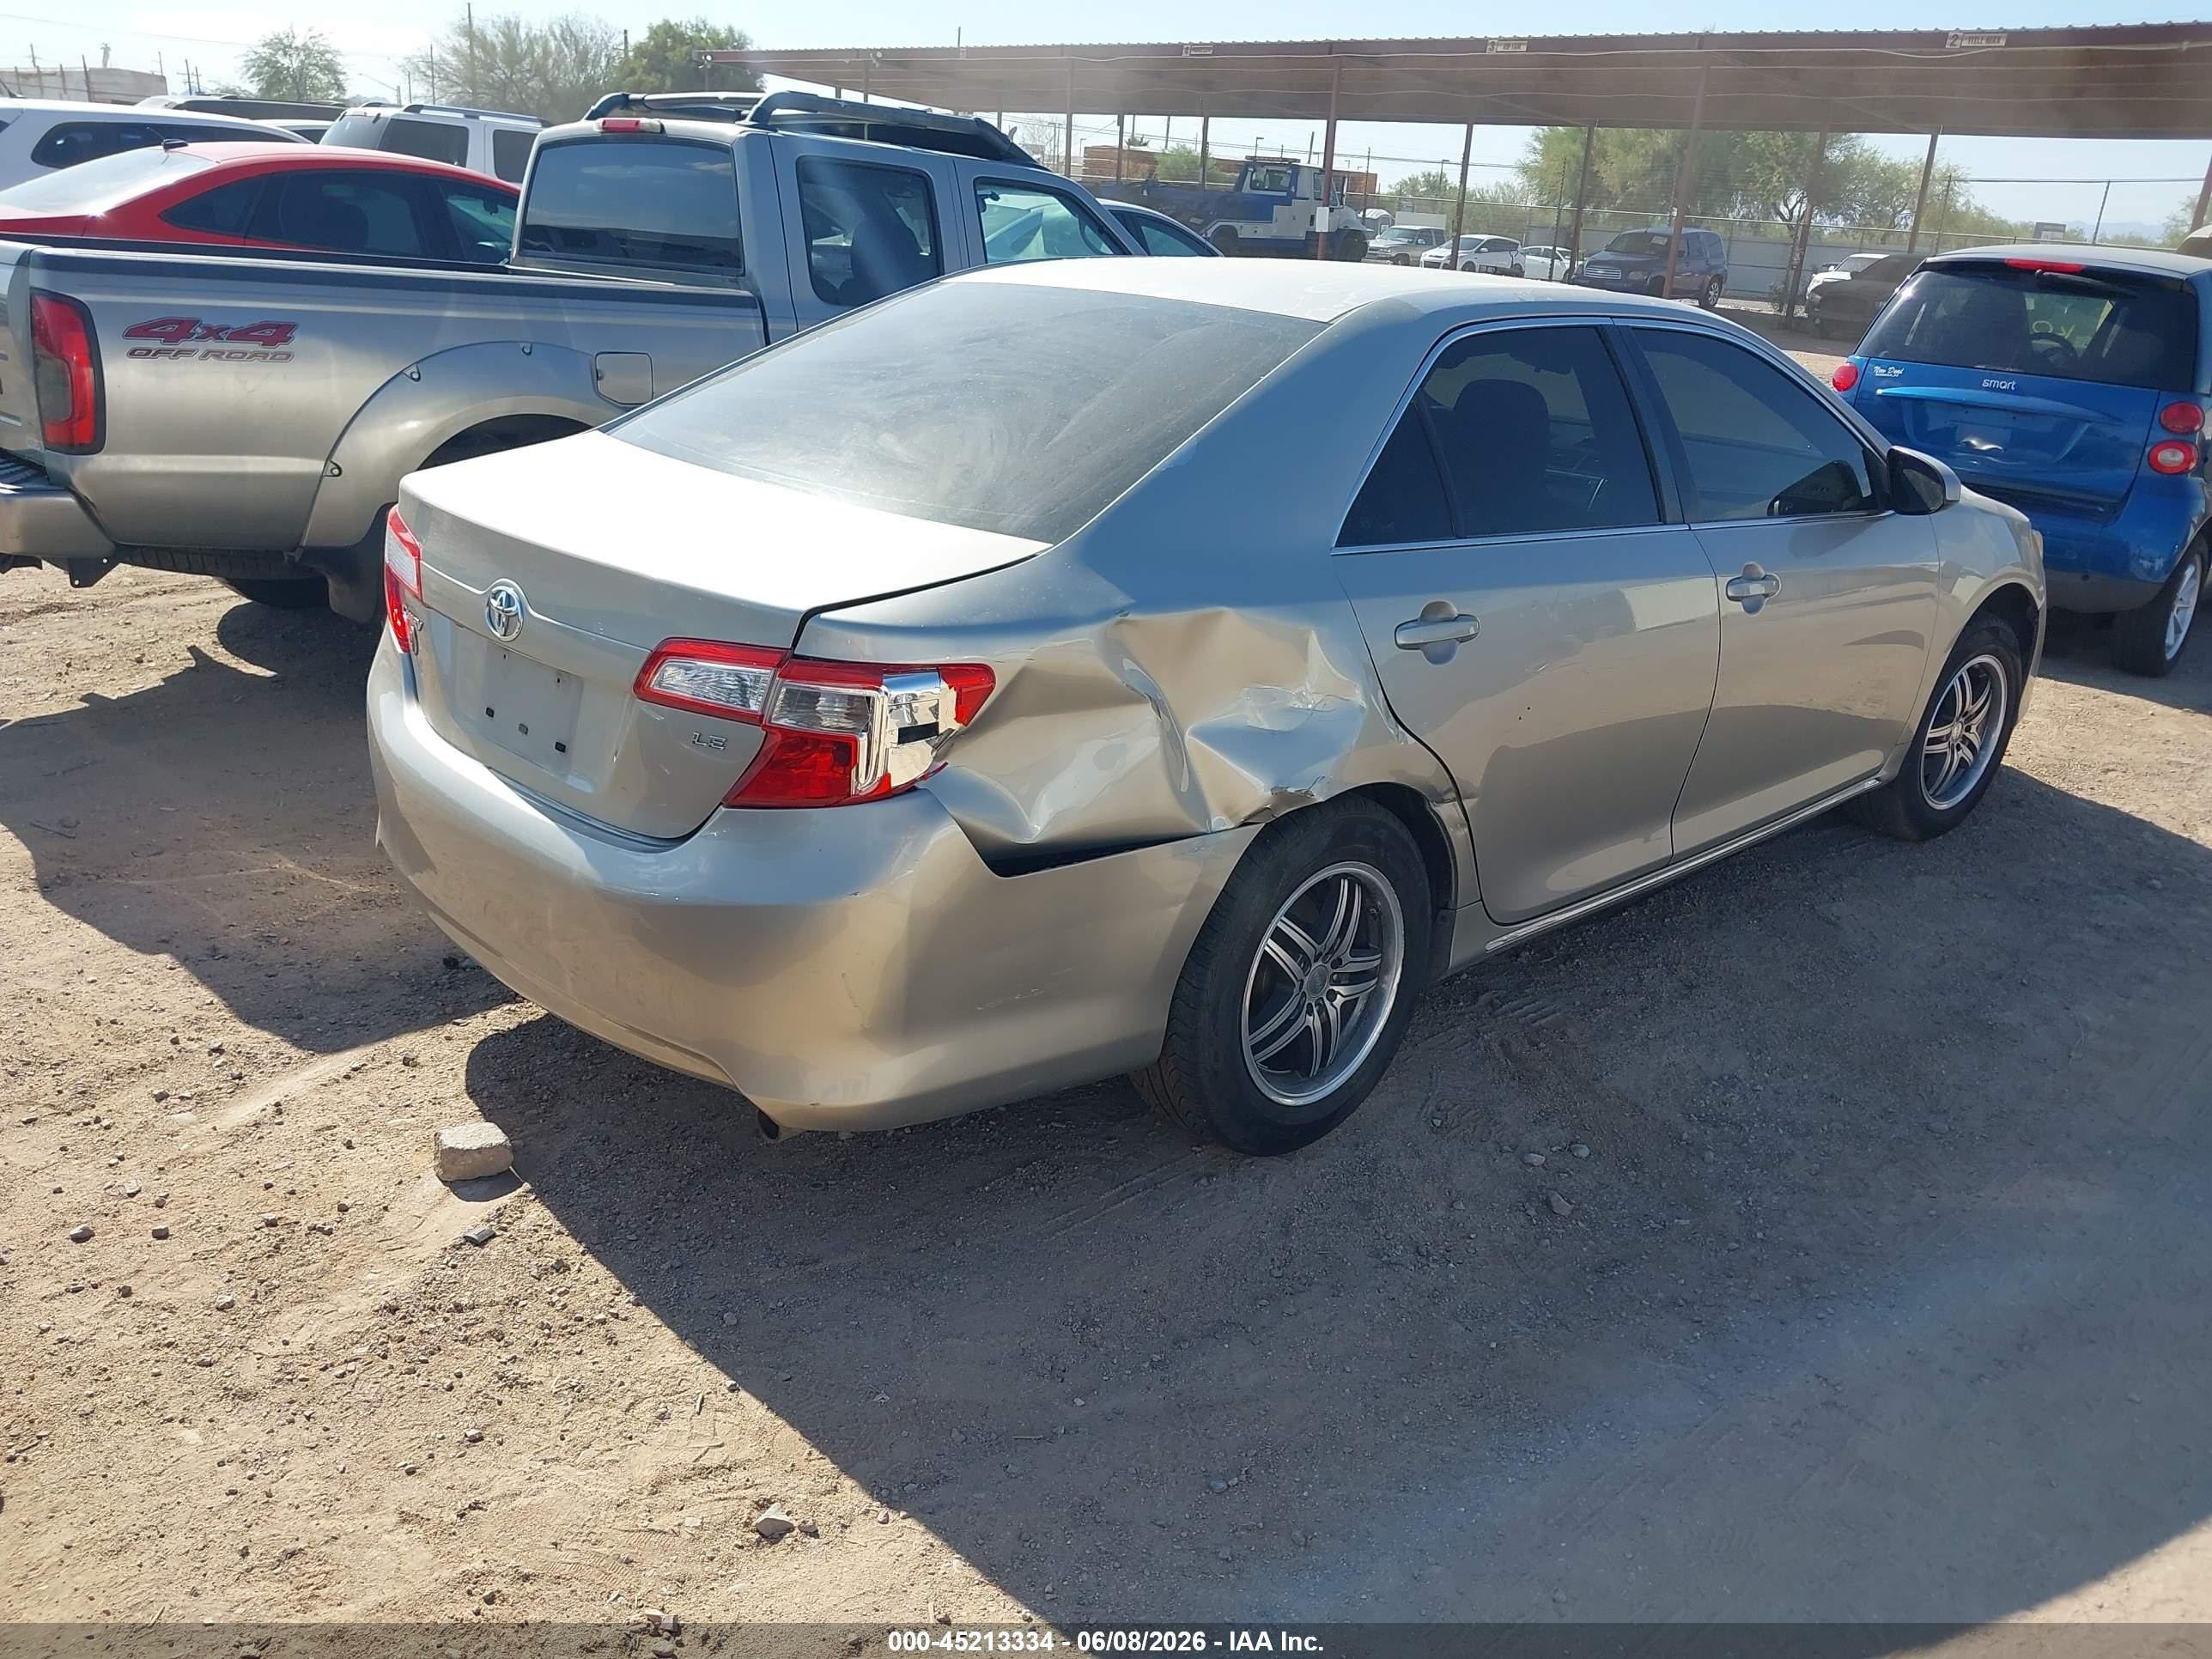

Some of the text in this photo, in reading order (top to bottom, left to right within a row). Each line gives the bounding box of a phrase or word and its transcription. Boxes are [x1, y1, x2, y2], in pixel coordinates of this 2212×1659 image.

[1948, 33, 1959, 46] 2
[123, 316, 300, 349] 4x4
[126, 346, 295, 363] OFF ROAD
[1982, 379, 2016, 391] smart
[692, 732, 726, 750] LE
